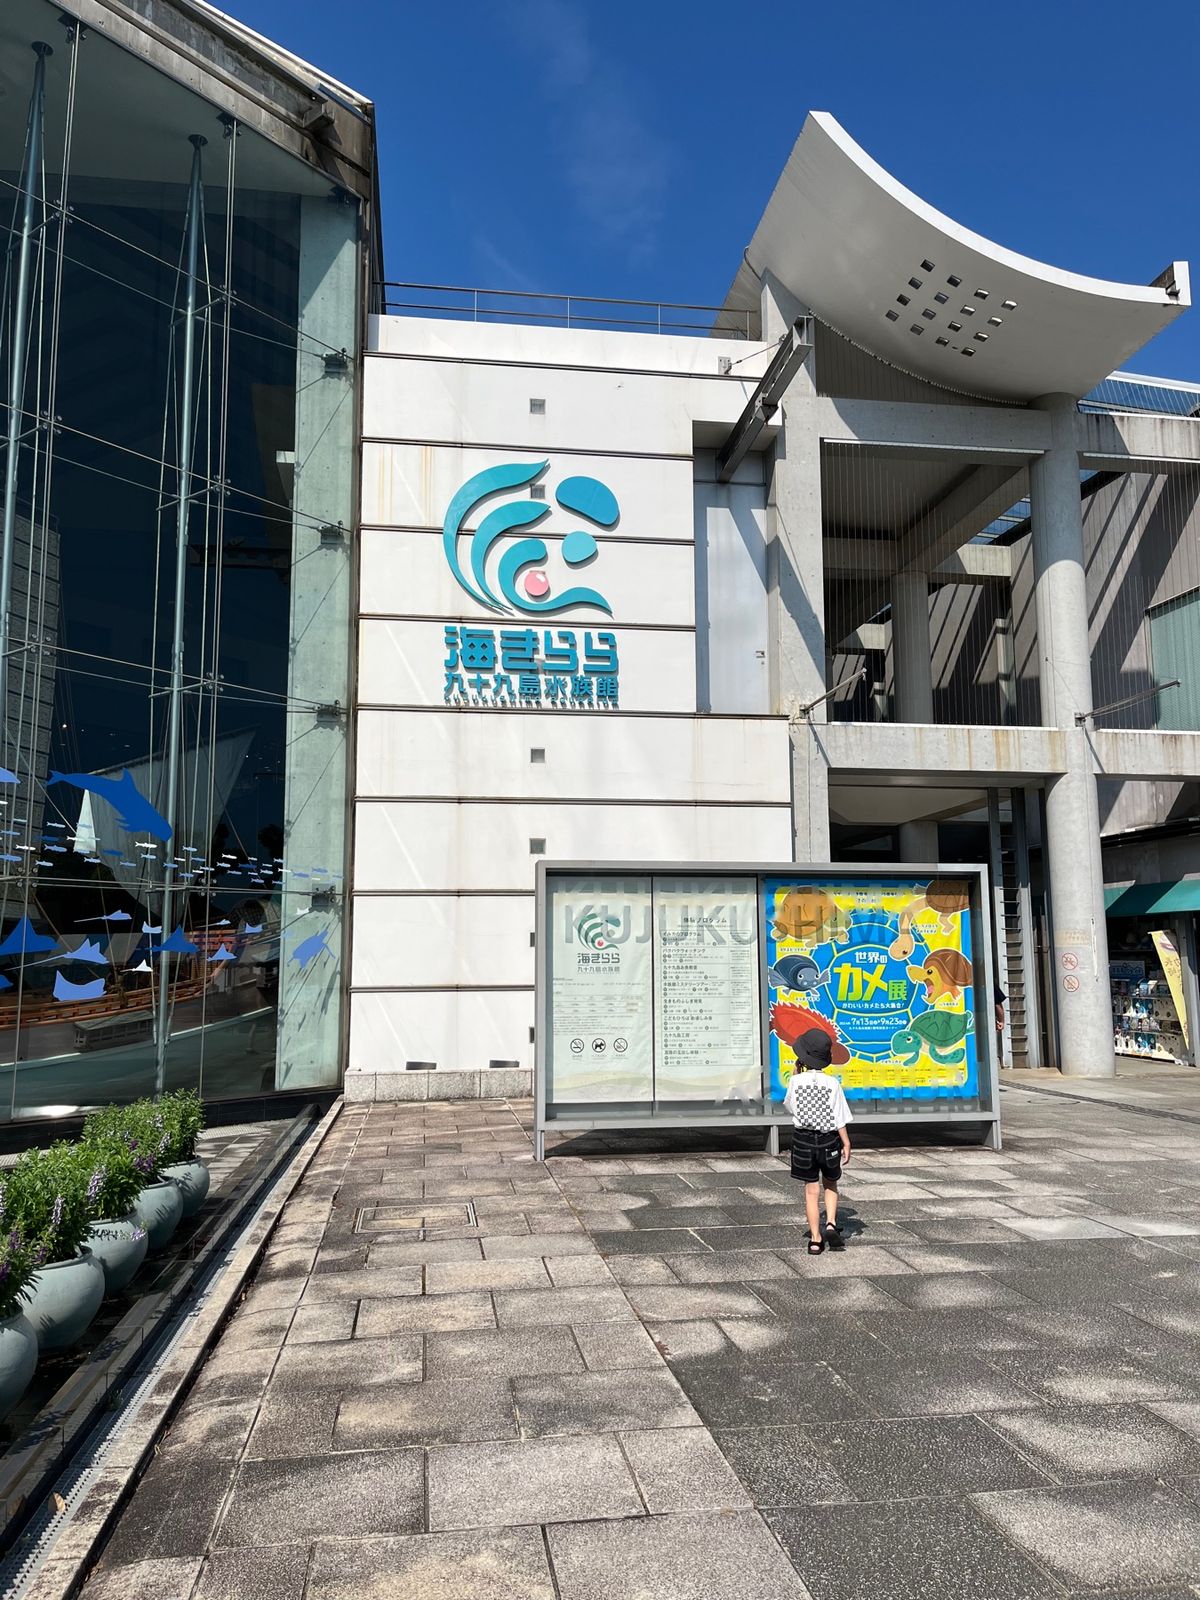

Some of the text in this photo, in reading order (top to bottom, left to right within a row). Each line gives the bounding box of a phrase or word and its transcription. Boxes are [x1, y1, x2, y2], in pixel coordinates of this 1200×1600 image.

[444, 625, 618, 672] 海きらら
[444, 672, 618, 697] 九十九島水族館
[577, 952, 620, 964] 海きらら
[855, 951, 888, 964] 世界の
[833, 963, 908, 1001] カメ展
